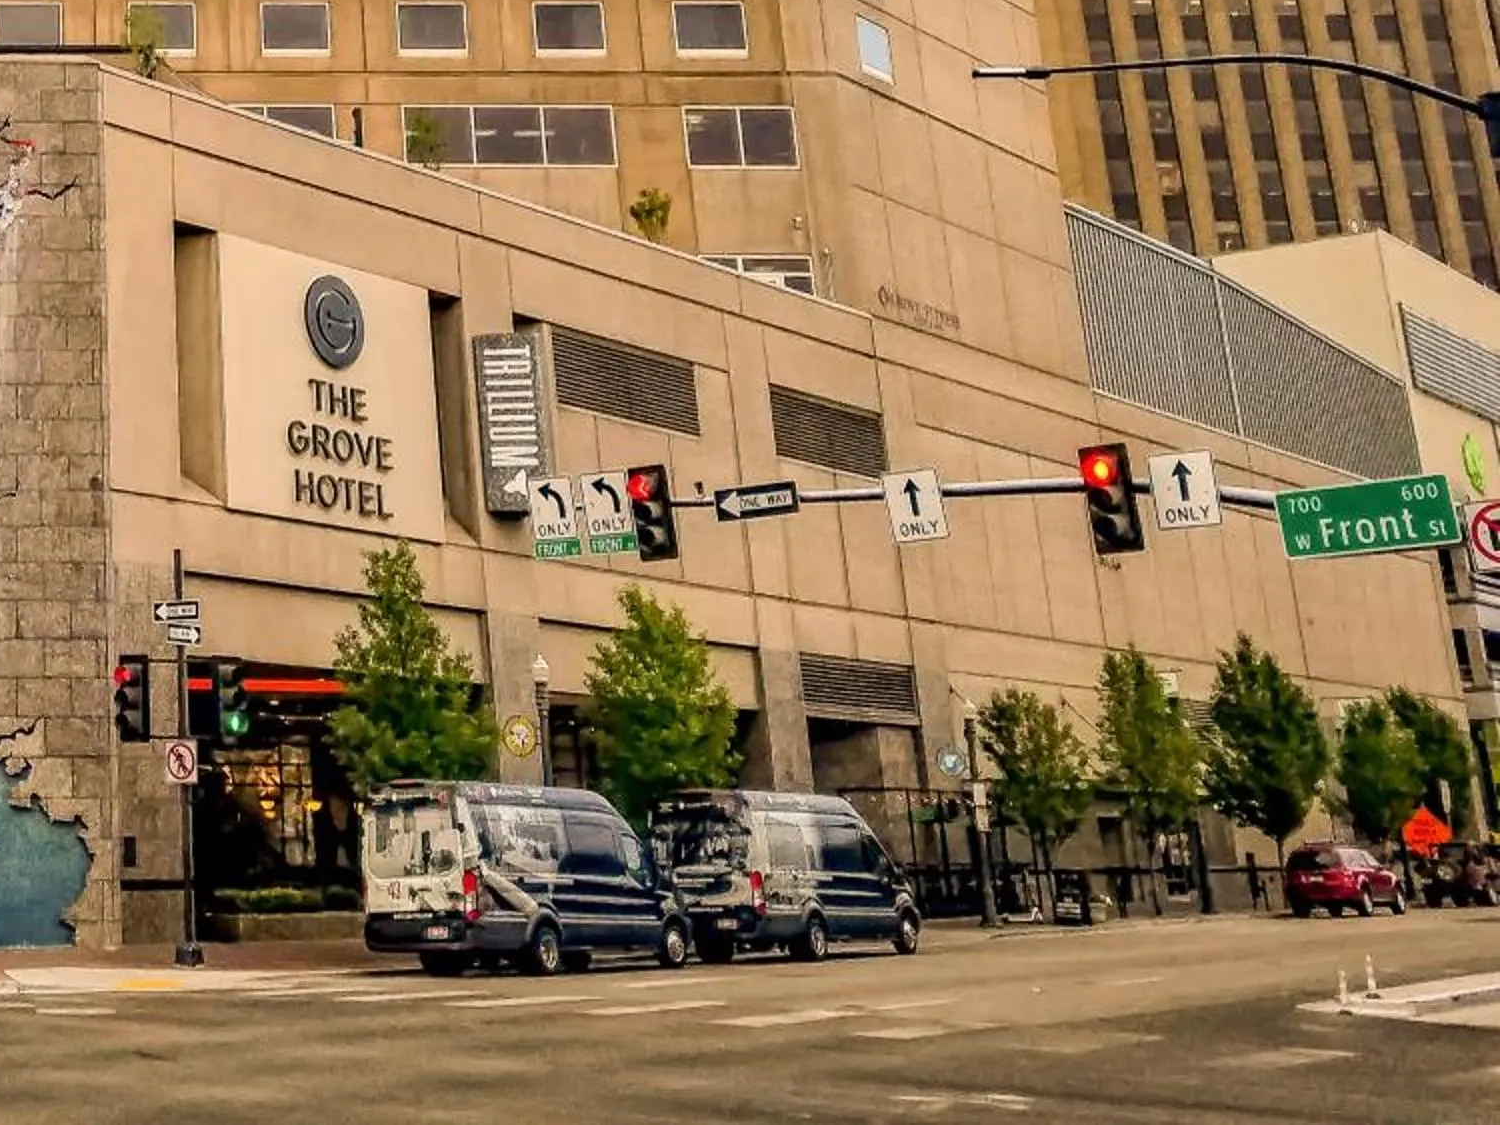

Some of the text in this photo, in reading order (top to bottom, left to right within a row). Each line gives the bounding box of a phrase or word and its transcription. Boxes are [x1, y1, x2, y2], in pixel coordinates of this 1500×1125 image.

[308, 378, 368, 424] THE
[483, 344, 539, 467] TRILLIUM
[287, 420, 395, 474] GROVE
[294, 469, 395, 521] HOTEL
[767, 492, 788, 505] WAY
[1401, 482, 1438, 501] 600
[1288, 496, 1321, 514] 700
[1165, 506, 1210, 523] ONLY
[538, 522, 571, 537] ONLY
[591, 518, 626, 532] ONLY
[899, 522, 940, 537] ONLY
[1319, 508, 1417, 548] Front
[1429, 519, 1448, 537] St
